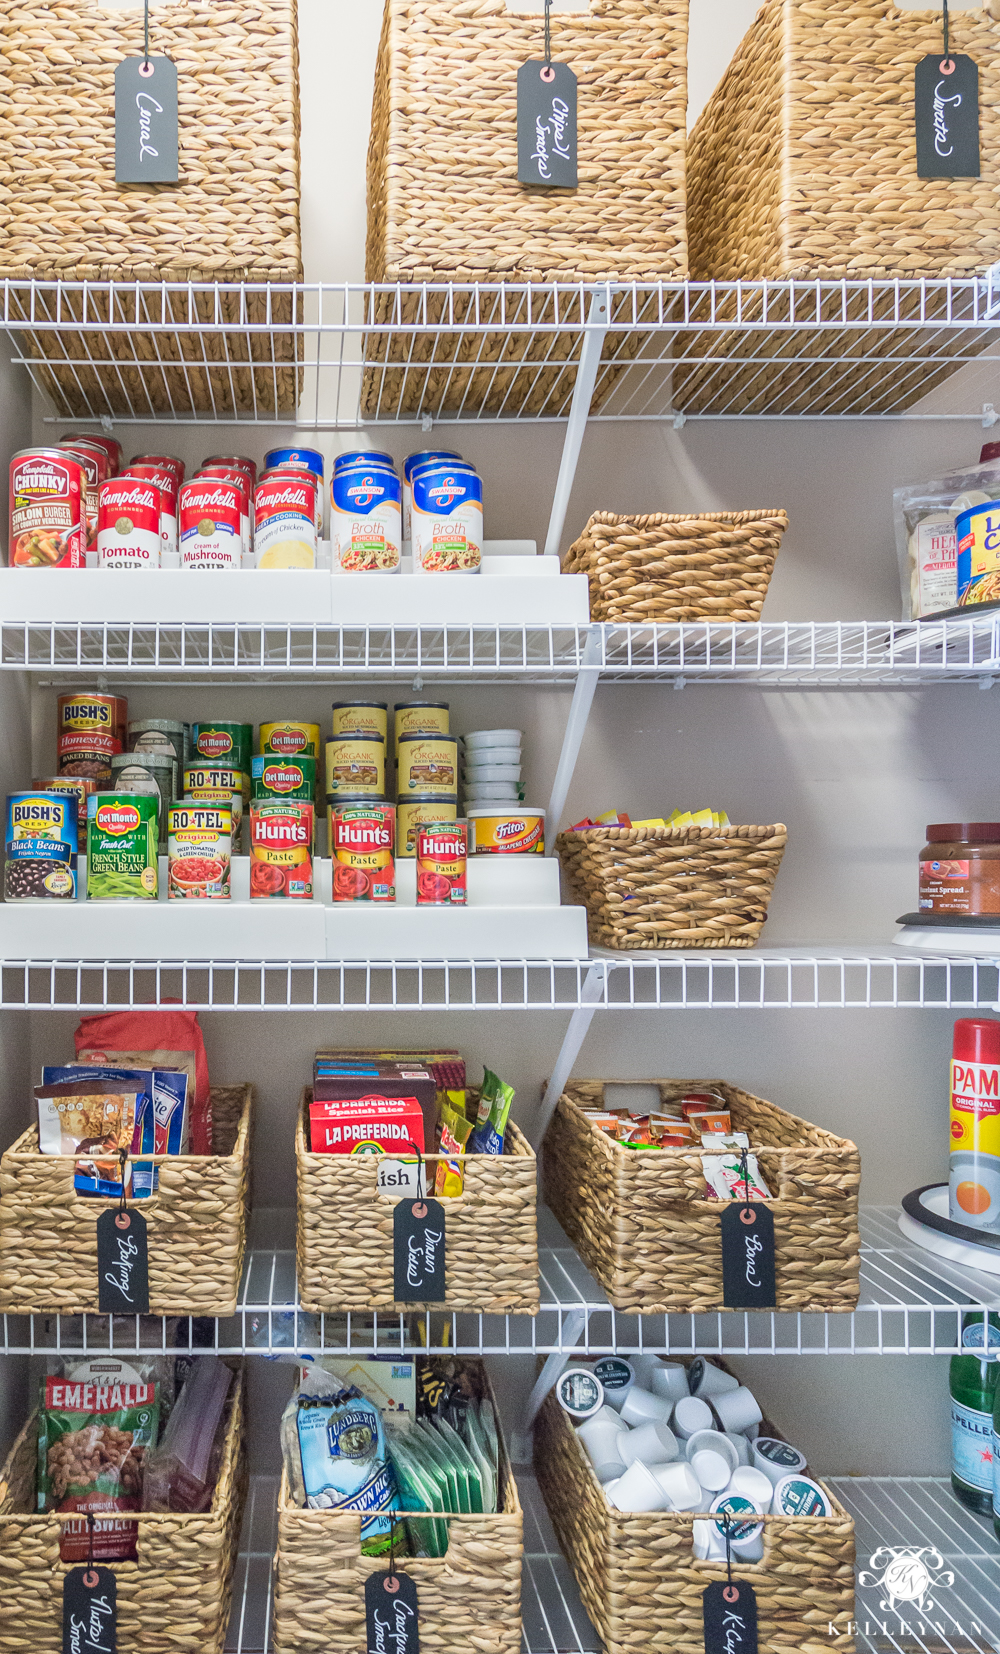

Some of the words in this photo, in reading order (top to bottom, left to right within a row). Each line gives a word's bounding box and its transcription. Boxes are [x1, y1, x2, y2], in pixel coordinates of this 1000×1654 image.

[932, 80, 962, 157] Sweets
[135, 91, 164, 162] Cereal
[530, 114, 552, 179] Snacks
[22, 464, 56, 475] Campbell's
[15, 474, 66, 492] CHUNKY
[431, 487, 464, 495] SWANSON
[99, 487, 157, 510] Campbell's
[181, 488, 238, 511] Campbell's
[255, 487, 308, 511] Campbell's
[12, 507, 43, 526] SIRLOIN
[43, 506, 71, 519] BURGER
[275, 513, 303, 521] COOKING
[279, 523, 304, 533] Chicken
[351, 522, 385, 535] Broth
[432, 522, 466, 536] Broth
[931, 535, 956, 550] HEA
[102, 547, 150, 559] Tomato
[183, 549, 232, 563] Mushroom
[942, 548, 956, 561] PA
[65, 705, 109, 722] BUSH'S
[342, 718, 378, 726] ORGANIC
[403, 718, 439, 726] ORGANIC
[61, 735, 114, 748] Homestyle
[199, 738, 208, 747] Del
[208, 737, 230, 747] Monte
[272, 737, 283, 745] Del
[283, 736, 305, 745] Monte
[62, 752, 84, 763] BAKED
[84, 752, 110, 763] BEANS
[336, 752, 374, 760] ORGANIC
[414, 752, 452, 761] ORGANIC
[265, 773, 277, 782] Del
[277, 772, 302, 782] Monte
[193, 791, 230, 799] Original
[14, 805, 62, 823] BUSH'S
[98, 813, 111, 823] Del
[111, 812, 138, 824] Monte
[273, 808, 299, 816] NATURAL
[356, 811, 382, 819] NATURAL
[108, 823, 126, 831] Quality
[255, 821, 307, 841] Hunt's
[496, 821, 525, 839] Fritos
[177, 833, 217, 841] Original
[338, 824, 391, 844] Hunt's
[11, 840, 33, 850] Black
[35, 841, 66, 852] Beans
[99, 839, 118, 850] Fresh
[117, 839, 135, 850] Cut
[423, 837, 466, 856] Hunt's
[92, 853, 120, 864] FRENCH
[121, 852, 145, 863] STYLE
[266, 851, 294, 861] Paste
[350, 855, 378, 865] Paste
[93, 862, 116, 872] GREEN
[118, 862, 144, 873] BEANS
[435, 864, 457, 873] Paste
[939, 886, 964, 895] Spread
[953, 1064, 999, 1097] PAM
[323, 1102, 337, 1110] LA
[341, 1100, 406, 1109] PREFERIDA
[956, 1096, 995, 1109] ORIGINAL
[328, 1108, 377, 1116] Spanish
[377, 1106, 404, 1115] Rice
[325, 1127, 342, 1146] LA
[344, 1124, 410, 1143] PREFERIDA
[406, 1235, 424, 1287] Sides
[745, 1234, 763, 1287] Bars
[104, 1235, 138, 1303] Baking
[52, 1384, 148, 1411] EMERALD
[328, 1411, 378, 1449] LUNDBERG
[374, 1473, 389, 1497] RIC
[77, 1503, 88, 1511] THE
